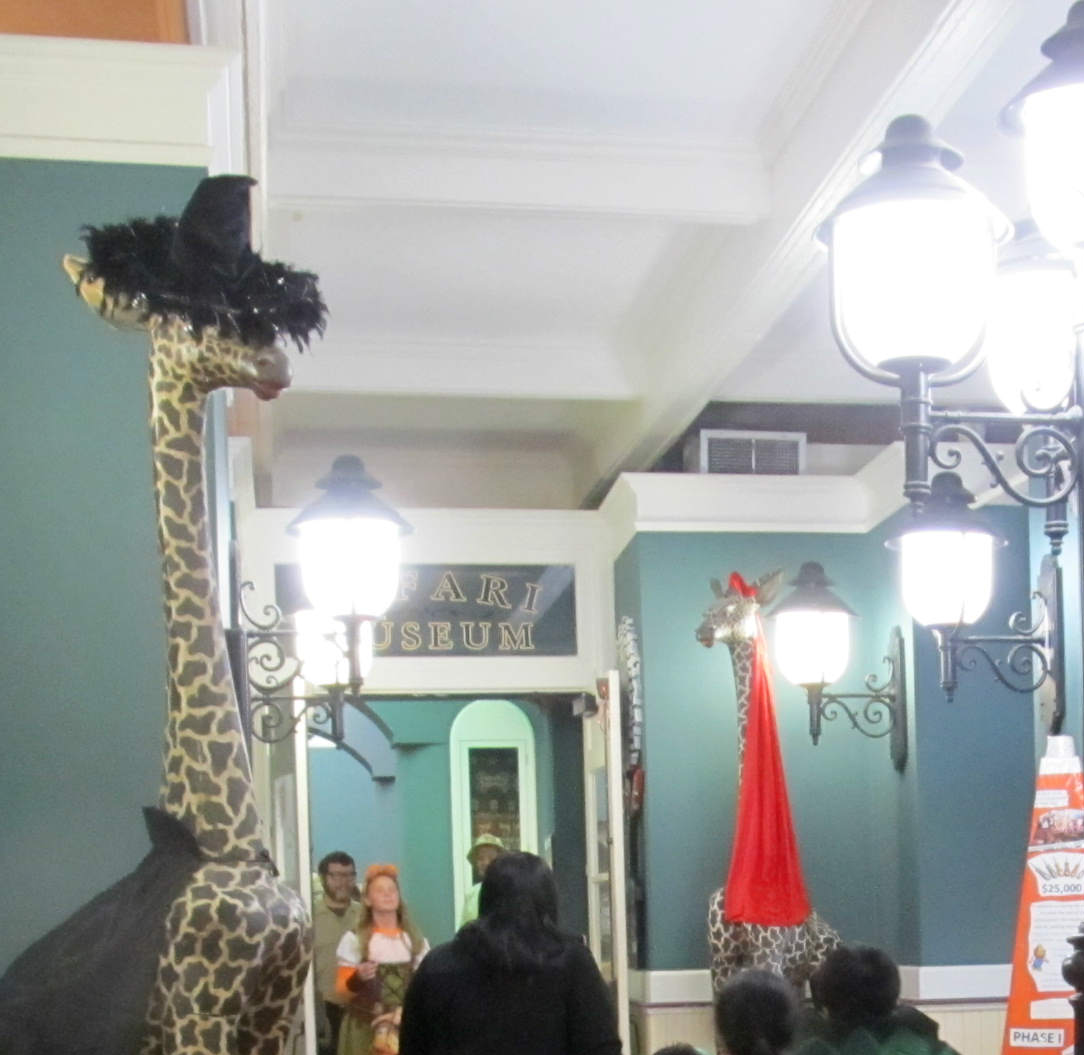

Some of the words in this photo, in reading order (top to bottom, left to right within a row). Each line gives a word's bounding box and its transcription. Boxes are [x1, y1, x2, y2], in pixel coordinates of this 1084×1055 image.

[400, 571, 542, 614] FARI
[372, 621, 535, 651] USEUM
[1041, 883, 1083, 893] $25,000
[1013, 1031, 1055, 1043] PHASE
